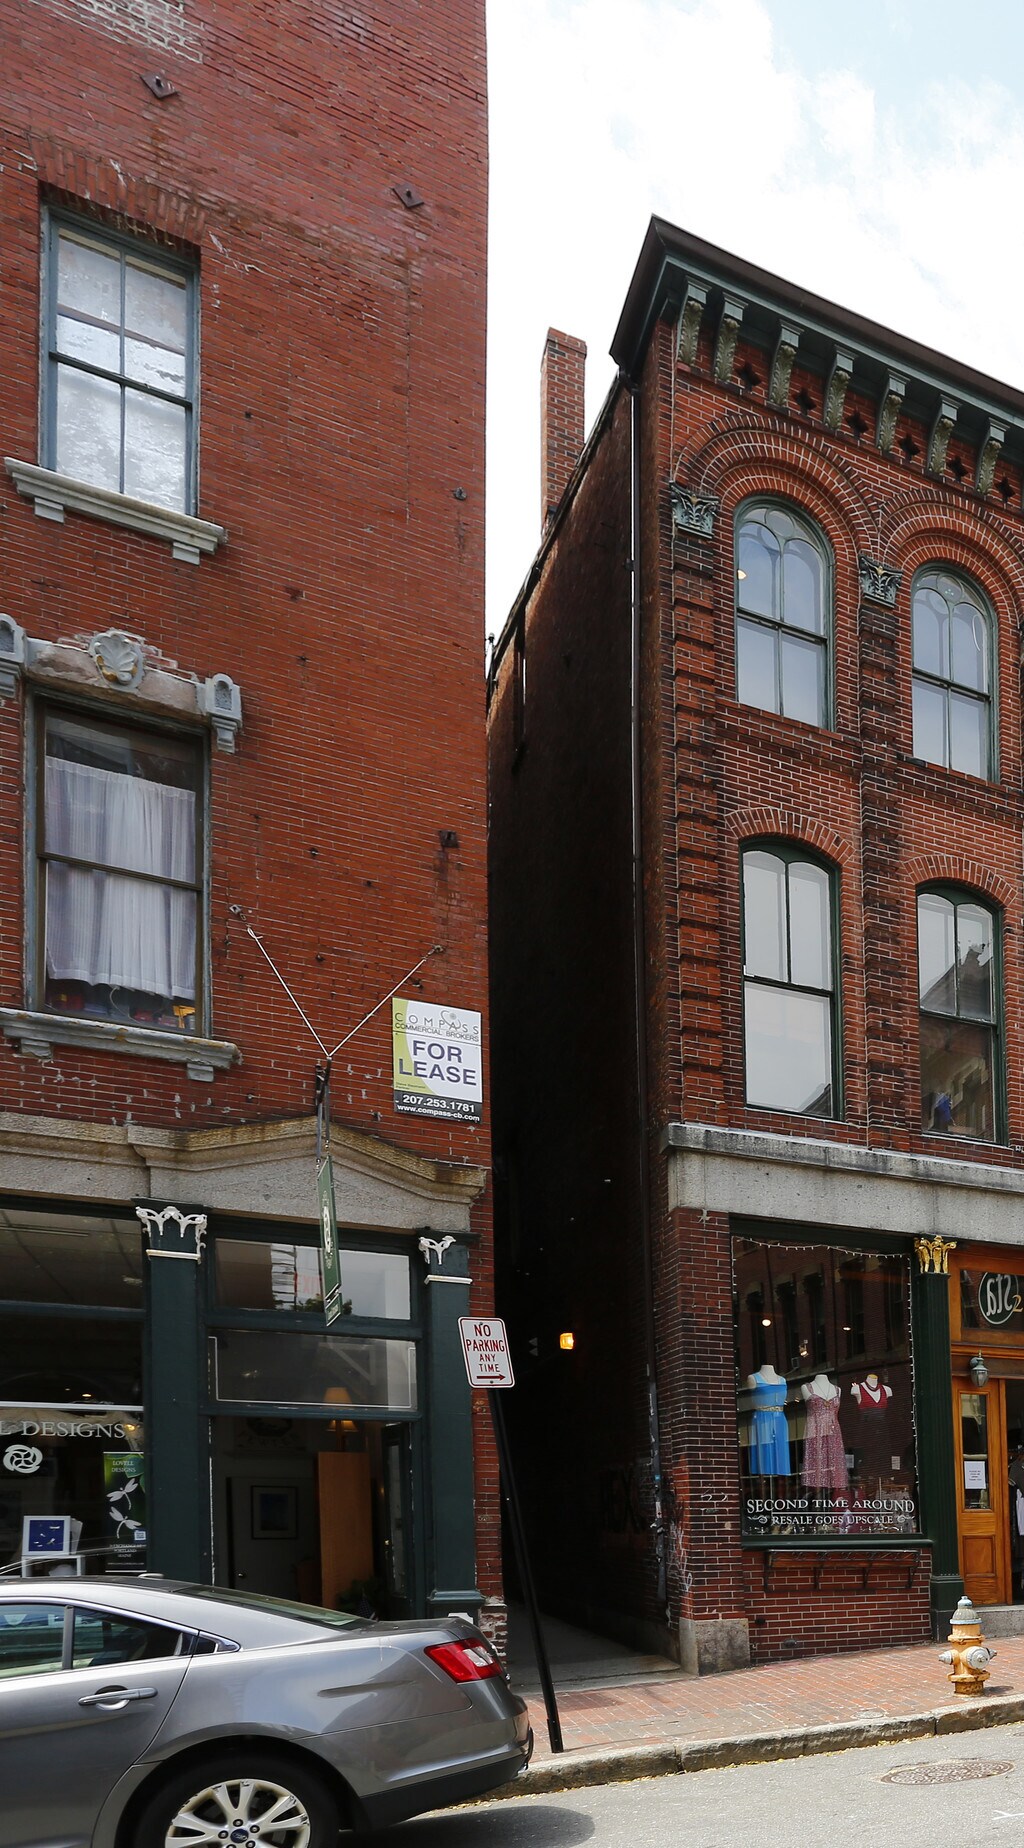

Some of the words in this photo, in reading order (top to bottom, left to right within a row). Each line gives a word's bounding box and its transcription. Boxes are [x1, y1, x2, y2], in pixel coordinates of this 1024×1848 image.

[395, 1013, 479, 1034] COMPASS
[395, 1022, 442, 1035] COMMERCIAL
[446, 1031, 479, 1042] BROKERS
[413, 1040, 462, 1063] FOR
[398, 1058, 477, 1086] LEASE
[402, 1094, 475, 1113] 207.253.1781
[397, 1104, 480, 1122] www.compass-cb.com
[474, 1324, 491, 1337] NO
[466, 1339, 505, 1352] PARKING
[479, 1353, 496, 1362] ANY
[479, 1364, 500, 1372] TIME
[21, 1421, 126, 1438] DESIGNS
[747, 1499, 808, 1514] SECOND
[812, 1499, 849, 1508] TIME
[853, 1499, 914, 1513] AROUND
[772, 1515, 812, 1524] RESALE
[816, 1515, 843, 1524] GOES
[848, 1515, 893, 1524] UPSCALE
